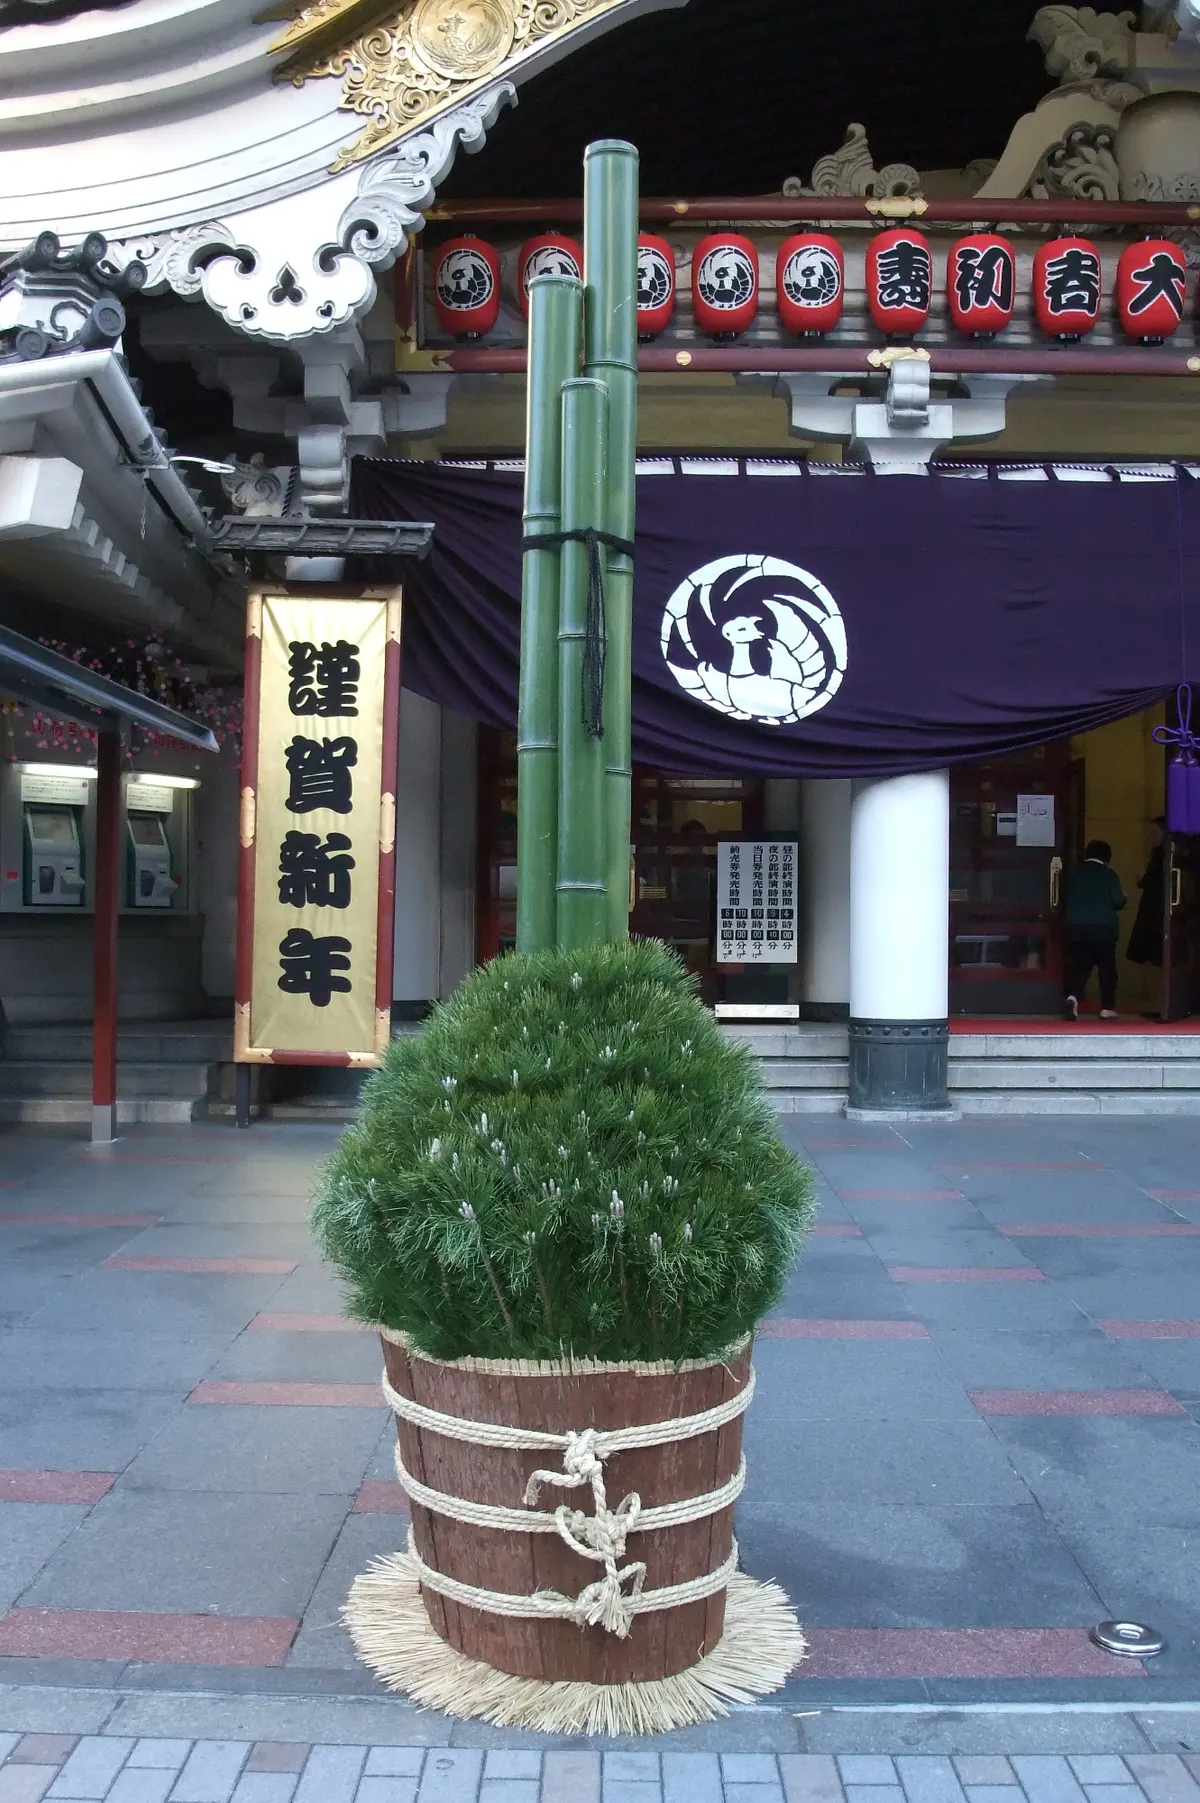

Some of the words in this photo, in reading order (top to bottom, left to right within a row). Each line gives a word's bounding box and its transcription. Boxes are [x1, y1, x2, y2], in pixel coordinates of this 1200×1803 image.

[277, 639, 361, 1007] 謹賀新年
[729, 845, 740, 906] 前売券発売時間
